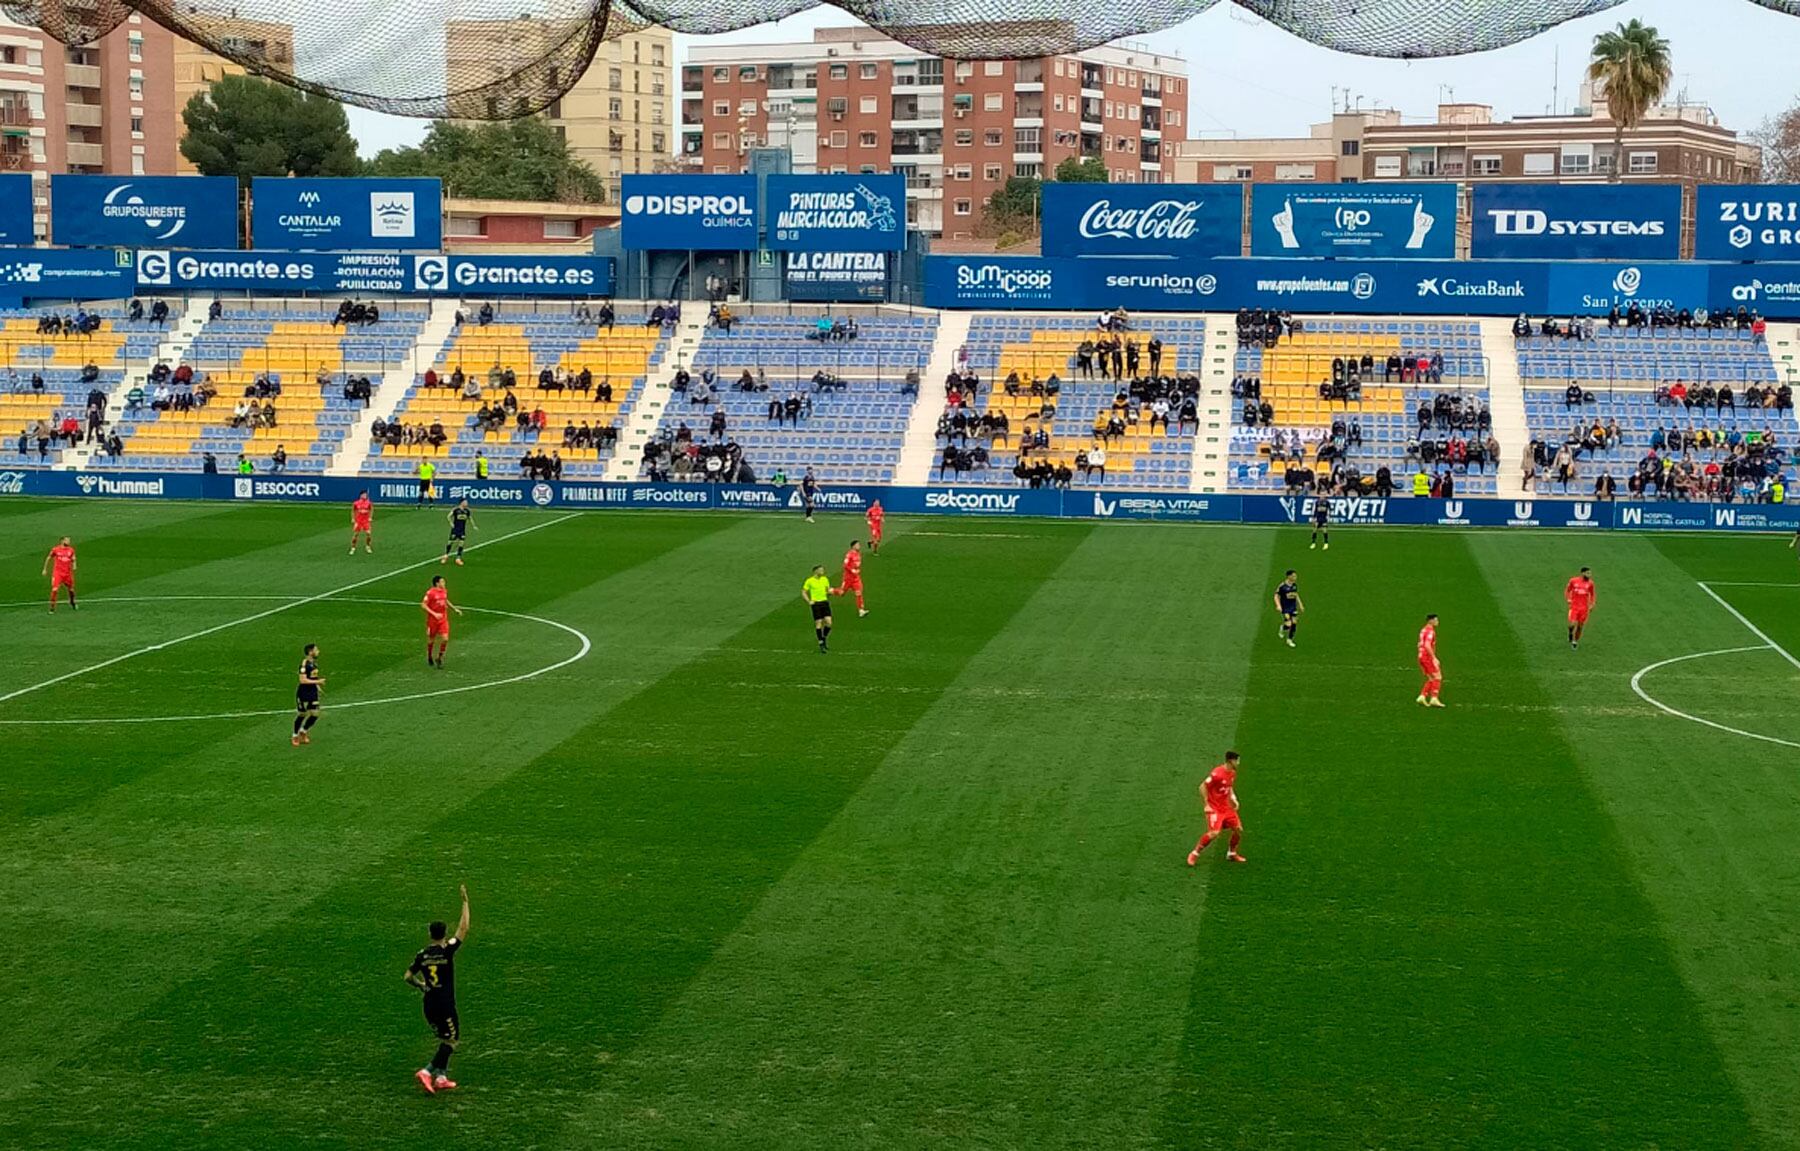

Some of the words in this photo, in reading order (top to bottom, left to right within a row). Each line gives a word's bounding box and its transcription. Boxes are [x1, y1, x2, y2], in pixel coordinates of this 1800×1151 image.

[103, 206, 186, 217] GRUPOSURESTE
[647, 195, 753, 214] DISPROL
[279, 215, 342, 226] CANTALAR
[702, 217, 753, 227] QUÍMICA
[1079, 199, 1205, 240] Coca-Cola
[1488, 210, 1548, 235] TD
[1549, 219, 1665, 236] SYSTEMS
[338, 254, 400, 265] -IMPRESIÓN
[787, 252, 808, 270] LA
[812, 252, 885, 270] CANTERA
[177, 257, 315, 281] Granate.es
[333, 266, 405, 277] -ROTULACIÓN
[455, 262, 595, 286] Granate.es
[787, 271, 806, 281] CON
[807, 271, 818, 281] EL
[819, 271, 852, 281] PRIMER
[853, 271, 886, 283] EQUIPO
[1106, 274, 1194, 288] serunion
[1257, 276, 1350, 296] www.grupofuentes.com
[1441, 279, 1526, 297] CaixaBank
[1582, 294, 1609, 308] San
[98, 477, 164, 495] hummel
[255, 482, 321, 496] BESOCCER
[463, 487, 523, 501] Footters
[562, 487, 605, 502] PRIMERA
[647, 489, 708, 503] Footters
[720, 490, 776, 503] VIVENTA
[925, 490, 1021, 509] setcomur
[1119, 499, 1166, 510] IBERIA
[1167, 500, 1209, 511] VITAE
[1302, 497, 1387, 519] EERYETI
[428, 965, 442, 988] 3
